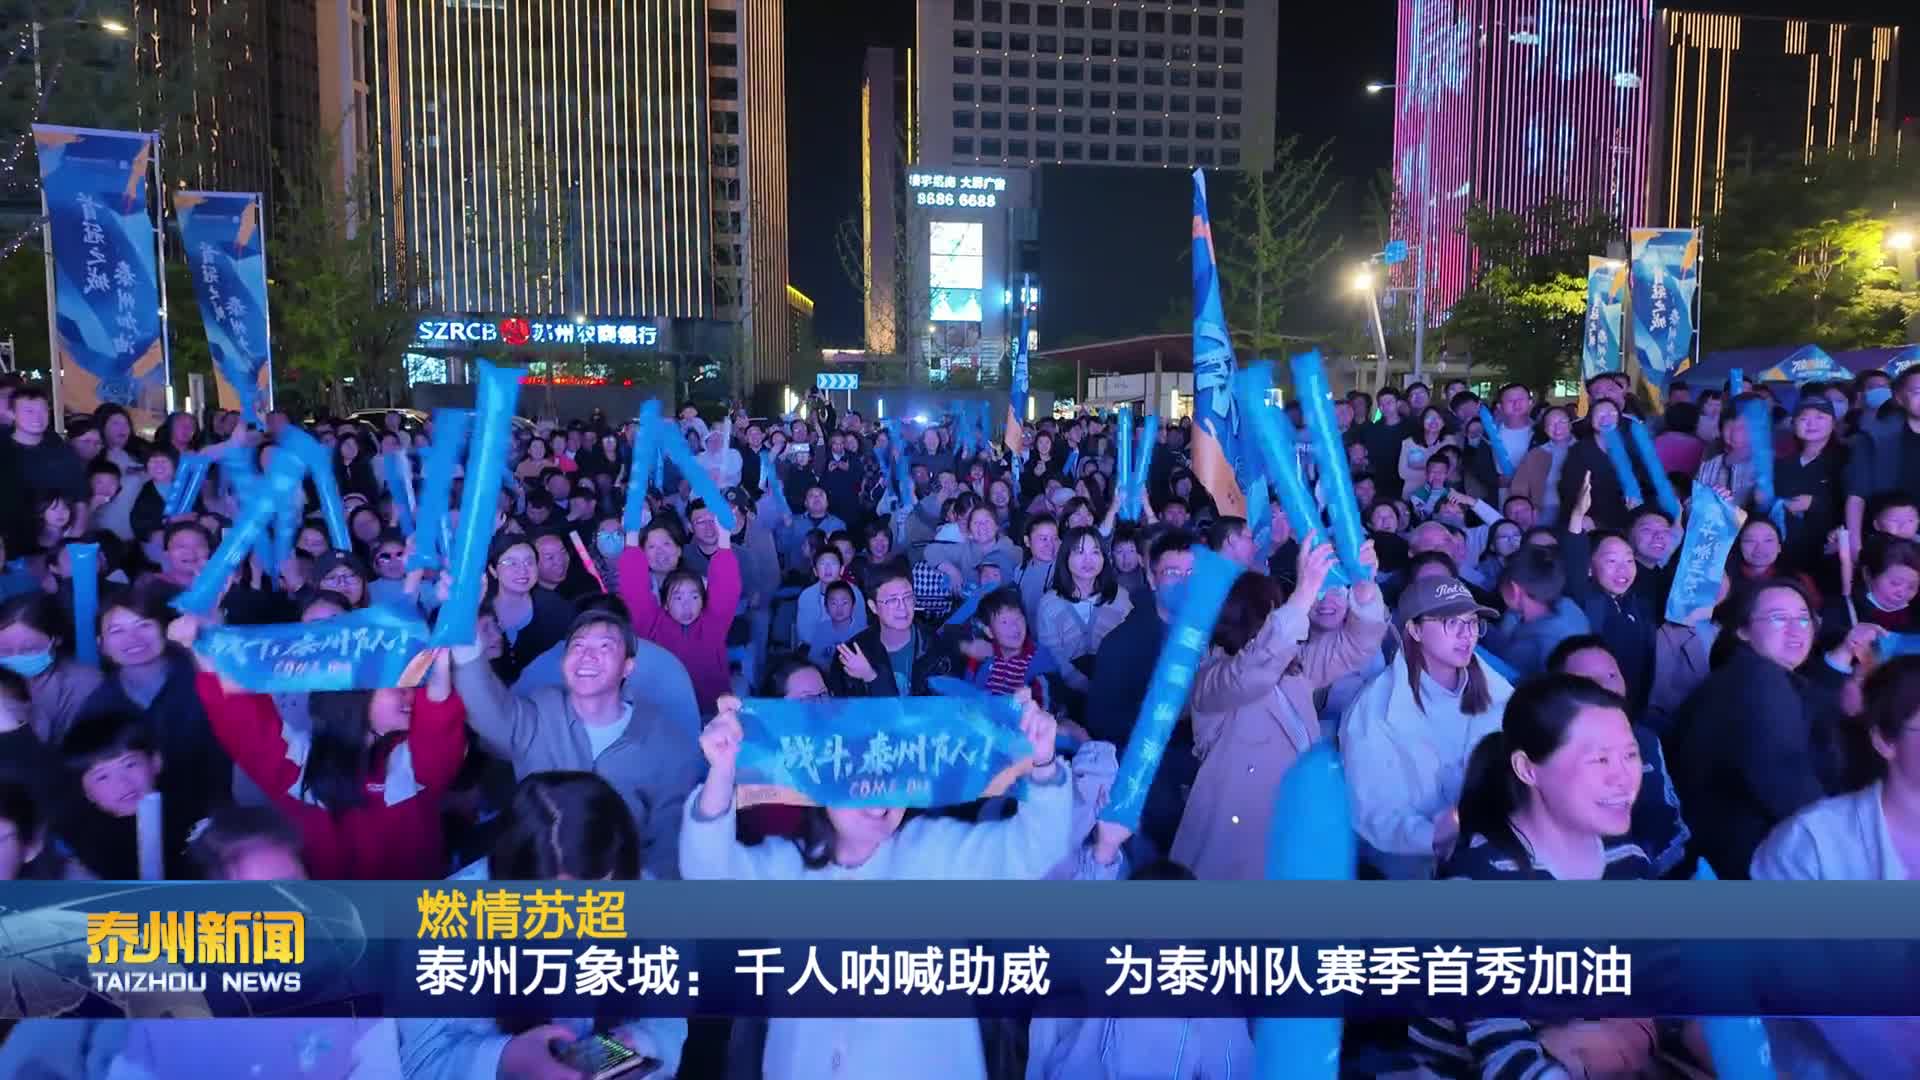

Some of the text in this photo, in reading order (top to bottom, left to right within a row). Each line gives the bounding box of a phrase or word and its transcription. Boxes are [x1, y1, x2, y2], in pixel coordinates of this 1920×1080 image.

[418, 321, 498, 342] SZRCB
[532, 322, 657, 345] 苏州农商银行
